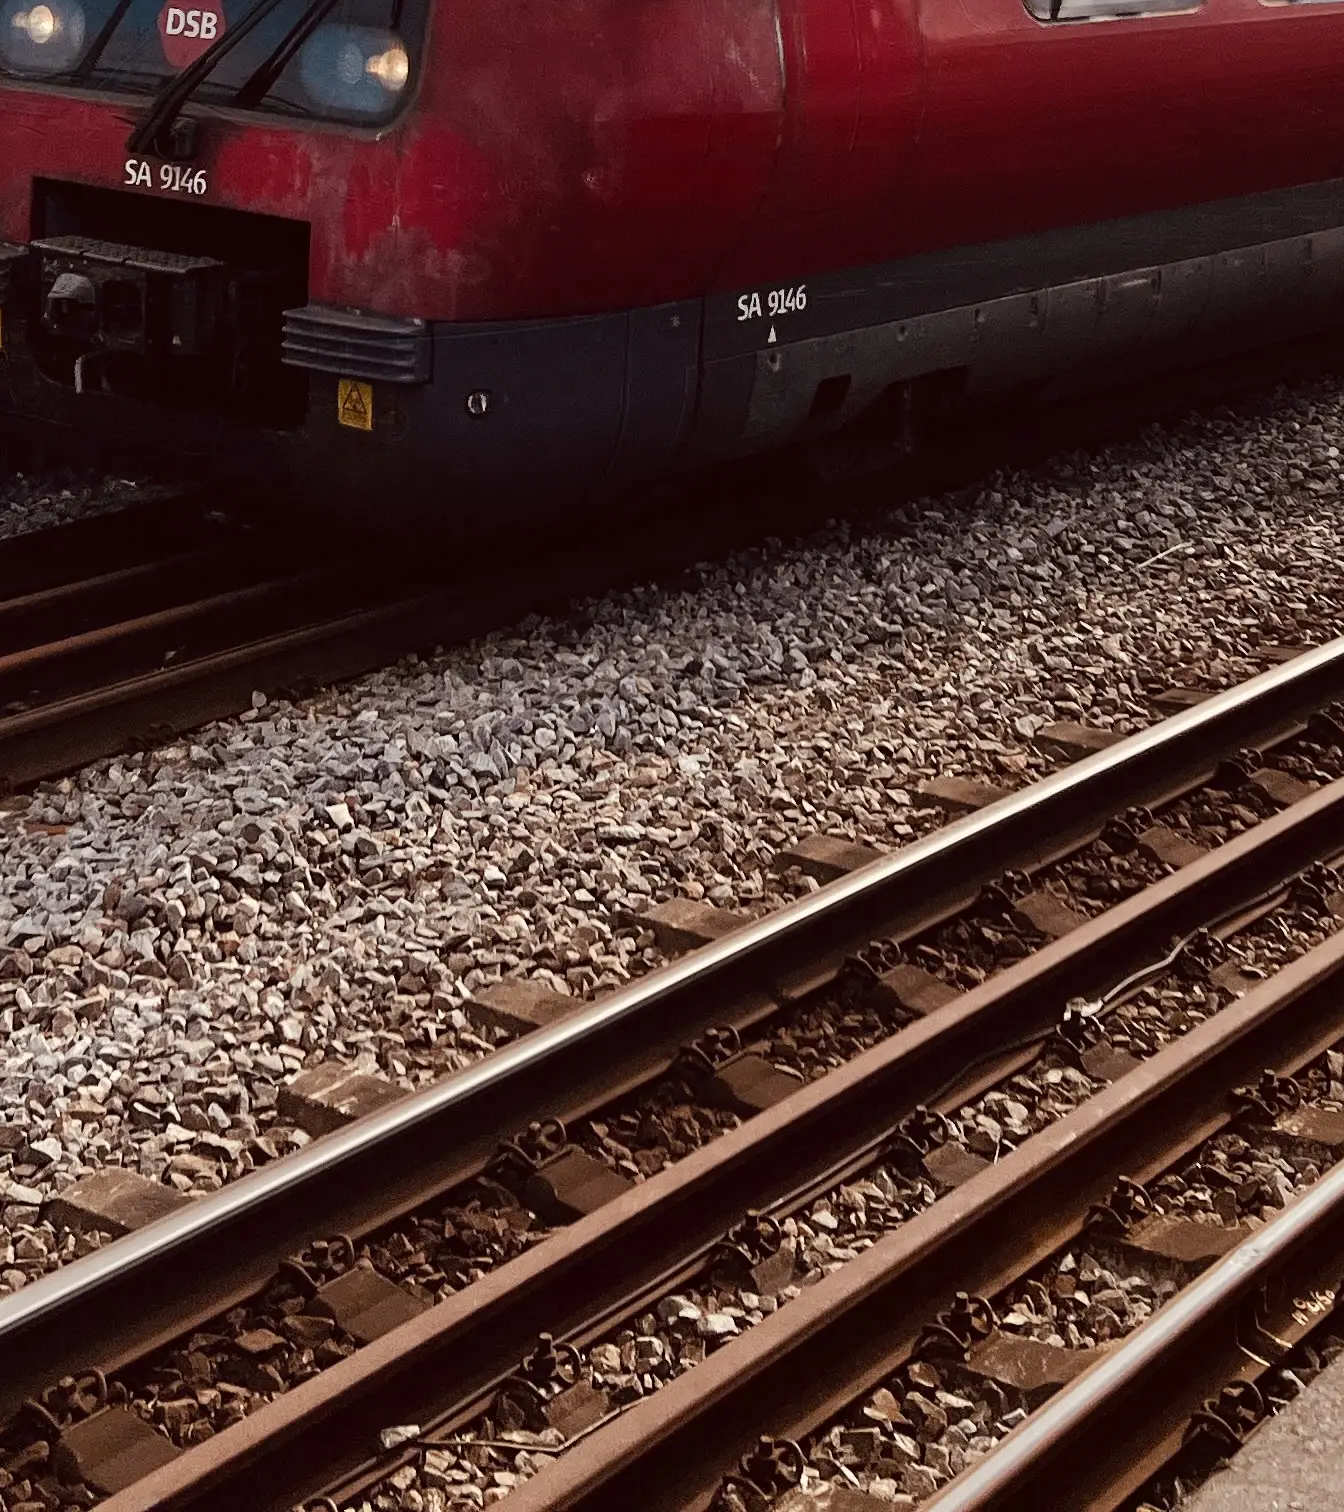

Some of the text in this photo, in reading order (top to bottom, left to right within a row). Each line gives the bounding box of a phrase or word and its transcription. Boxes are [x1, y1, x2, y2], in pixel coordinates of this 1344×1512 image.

[165, 7, 218, 40] DSB
[124, 159, 207, 195] SA 9146
[737, 284, 807, 321] SA 9146
